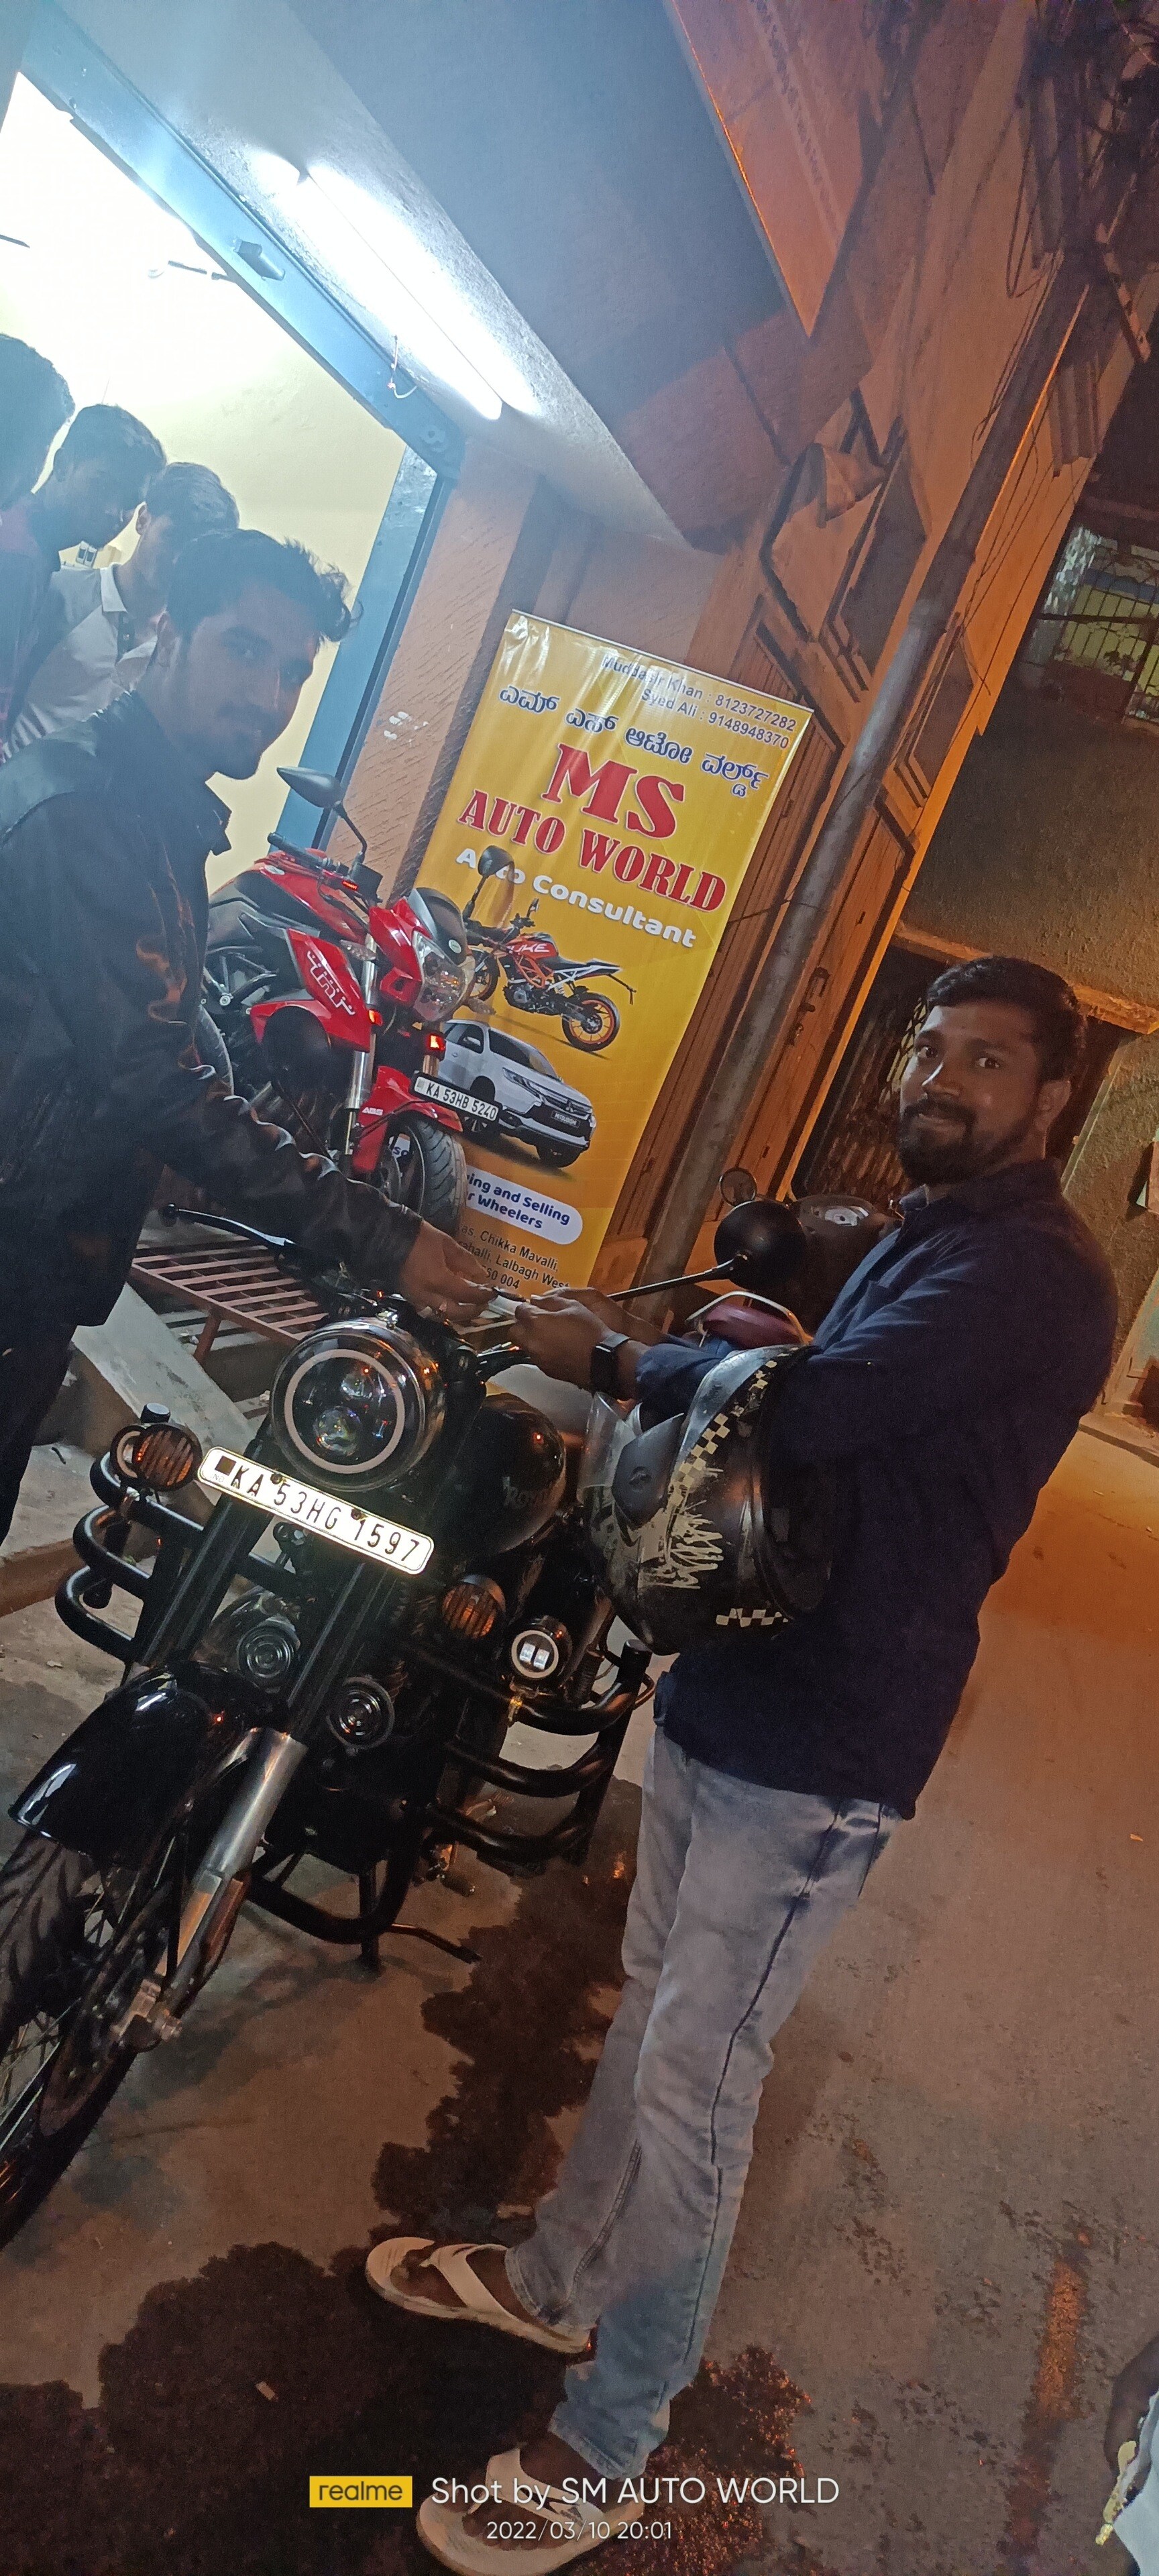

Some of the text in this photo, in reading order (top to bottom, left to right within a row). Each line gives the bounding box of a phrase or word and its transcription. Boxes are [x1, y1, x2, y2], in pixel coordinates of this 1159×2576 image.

[641, 689, 674, 710] Syed
[677, 702, 698, 717] Ali
[708, 712, 790, 749] 9148948370
[667, 676, 702, 700] Khan
[715, 695, 796, 732] 8123727282
[541, 743, 685, 840] MS
[457, 789, 726, 912] AUTO WORLD
[456, 848, 697, 949] Ato Consultant
[362, 1107, 384, 1116] ABS
[426, 1083, 497, 1120] KA 53HB 5240
[478, 1195, 543, 1229] Wheelers
[494, 1186, 521, 1203] and
[522, 1197, 570, 1226] Selling
[480, 1230, 516, 1253] Chikka
[519, 1246, 559, 1272] Mavalli,
[495, 1256, 539, 1280] Lalbagh
[482, 1265, 520, 1289] 50 004
[230, 1465, 421, 1562] KA 53HG 1597
